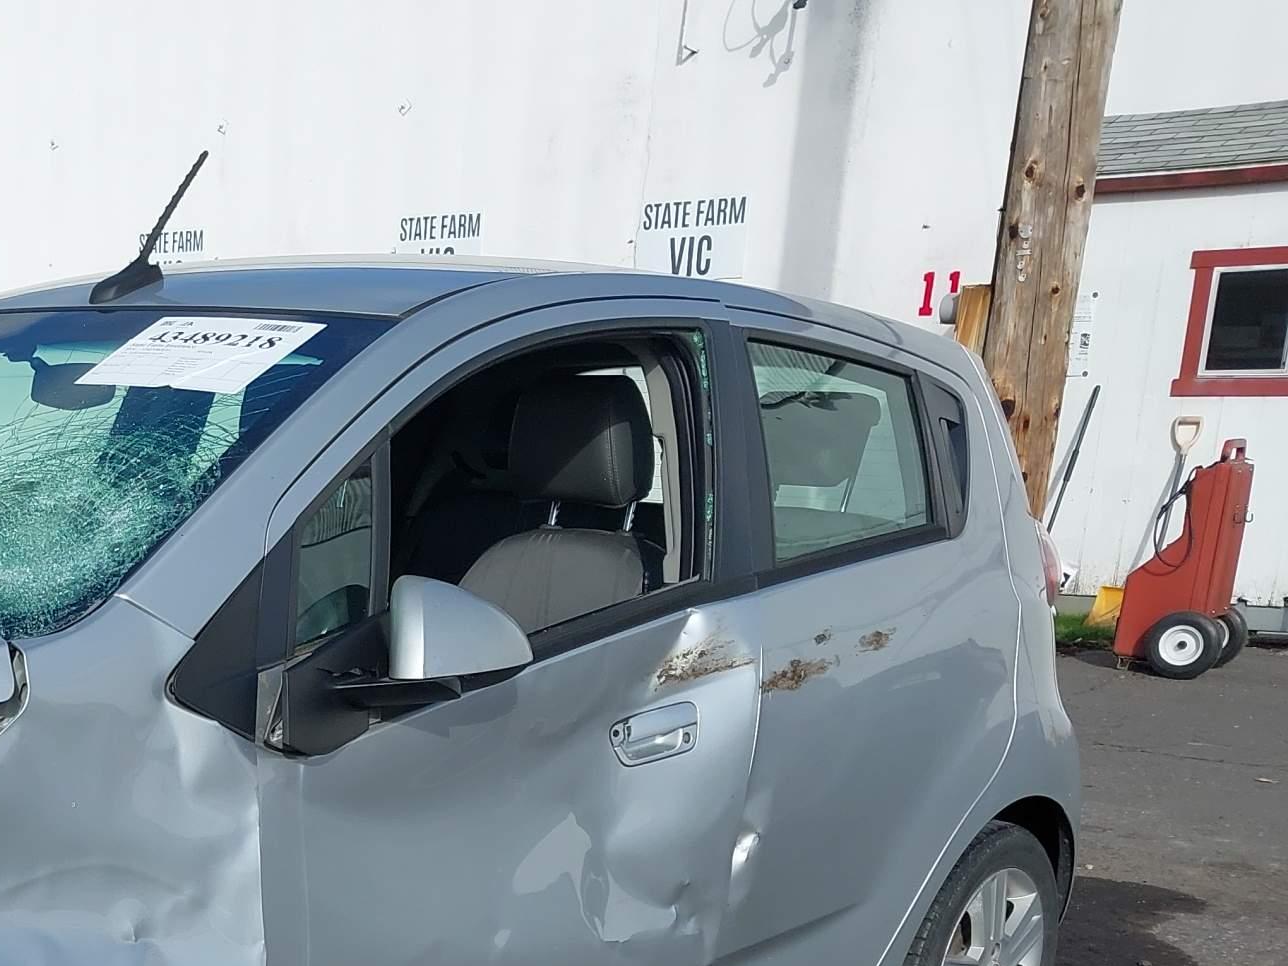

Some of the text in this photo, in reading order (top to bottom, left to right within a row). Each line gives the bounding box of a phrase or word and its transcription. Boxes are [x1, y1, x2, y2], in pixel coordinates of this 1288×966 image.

[399, 213, 481, 242] STATE FARM
[643, 196, 747, 231] STATE FARM
[139, 229, 204, 254] SATE FARM
[670, 235, 713, 277] VIC
[148, 329, 283, 350] 43489218
